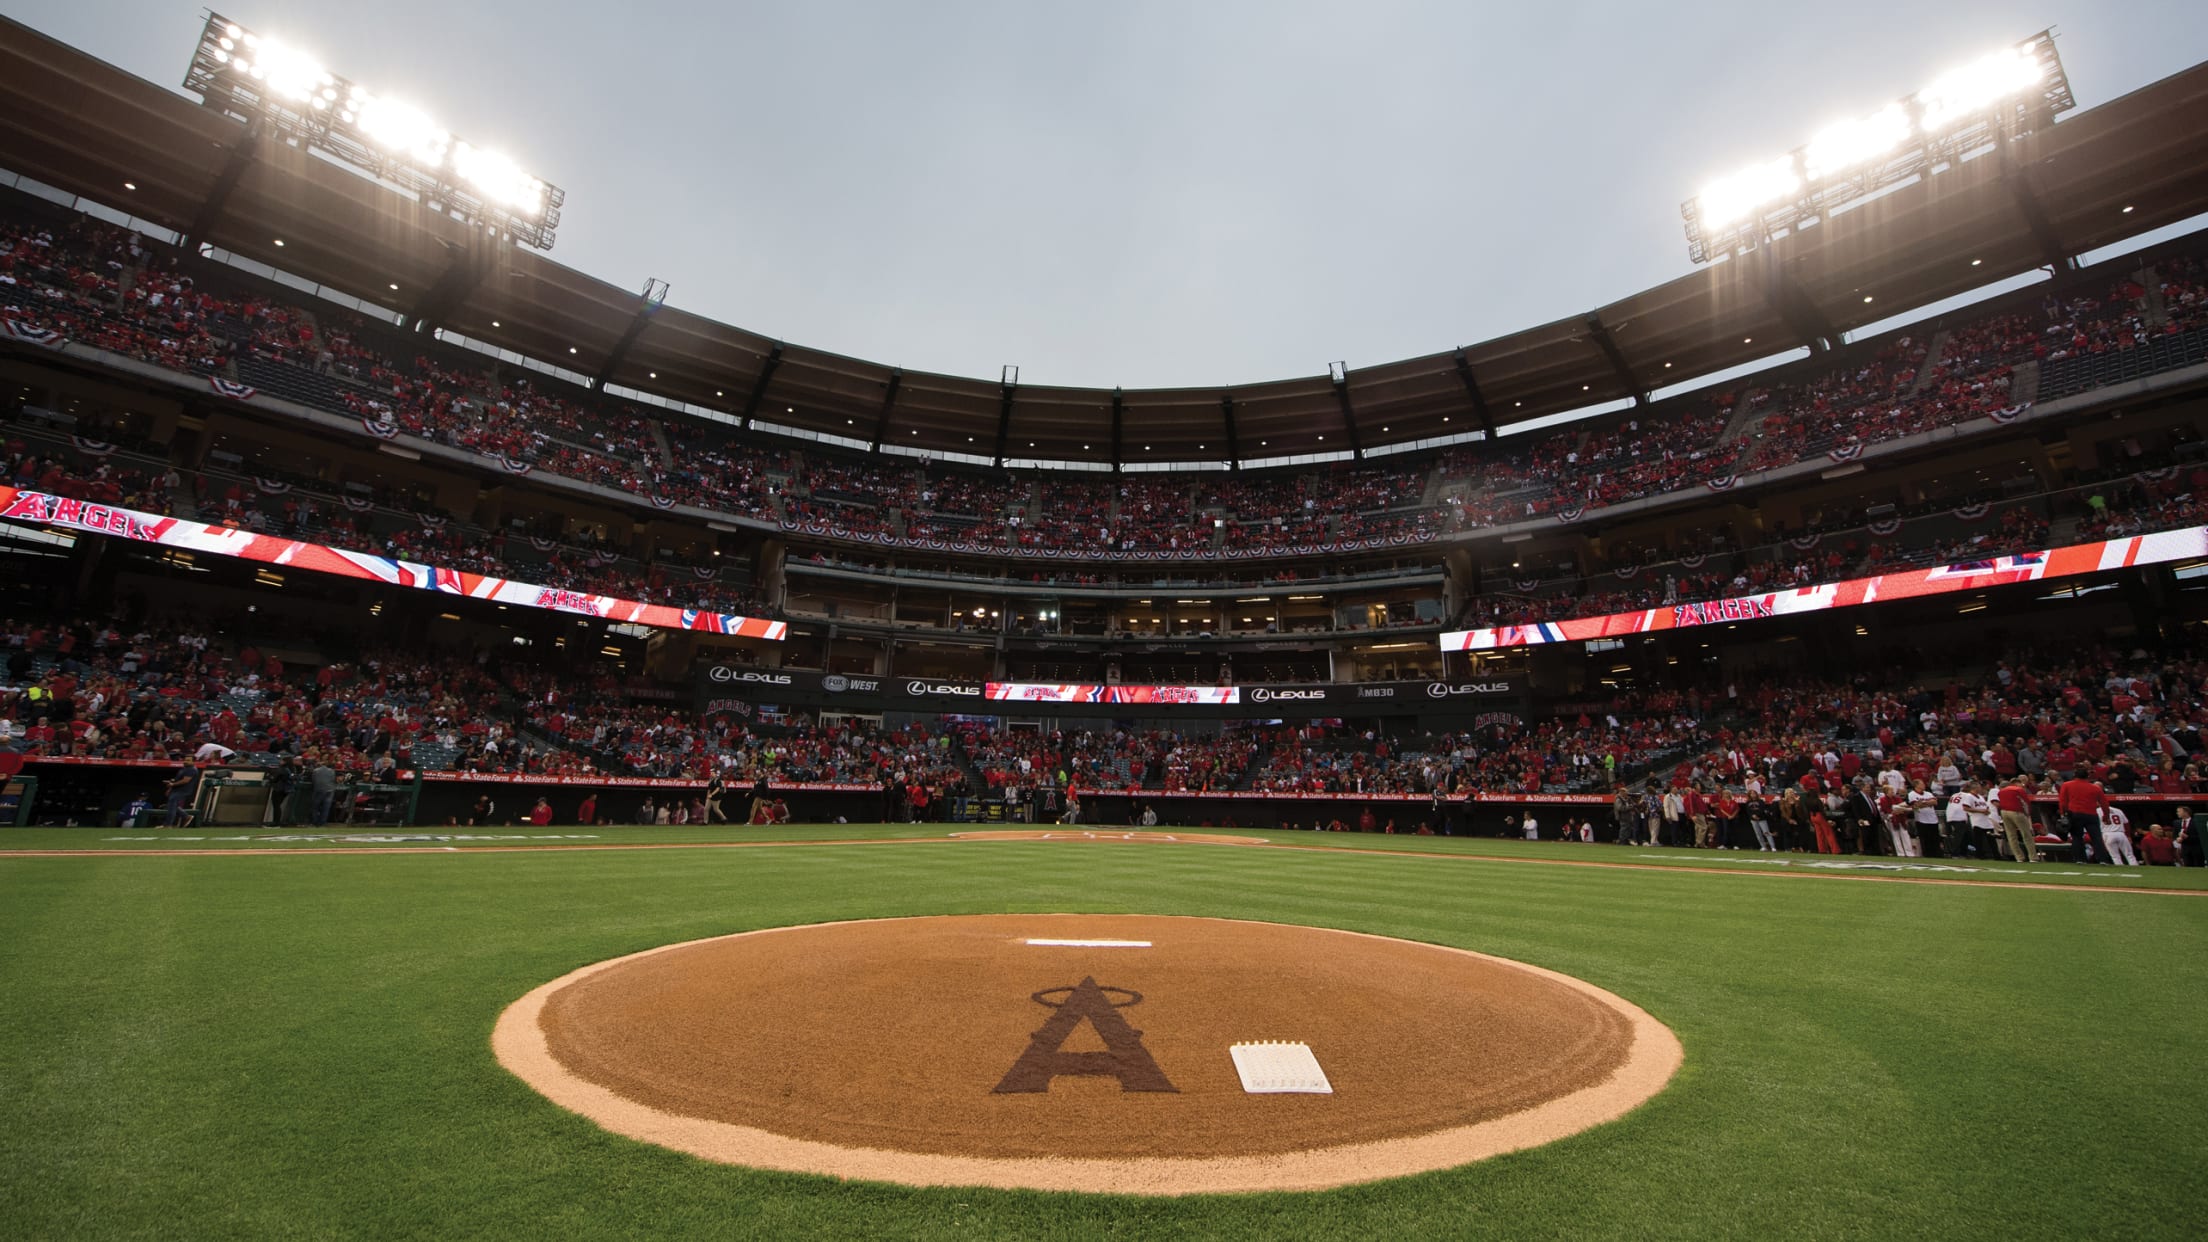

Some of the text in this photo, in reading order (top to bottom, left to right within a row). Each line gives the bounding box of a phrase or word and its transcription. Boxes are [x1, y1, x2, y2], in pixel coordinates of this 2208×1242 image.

[2, 491, 157, 542] ANGELS
[536, 589, 600, 616] ANGELS
[1676, 598, 1775, 627] ANGELS
[733, 671, 791, 684] LEXUS
[850, 679, 878, 690] WEST
[927, 684, 980, 696] LEXUS
[1449, 682, 1509, 694] LEXUS
[1270, 690, 1325, 700] LEXUS
[706, 699, 751, 717] ANGELS
